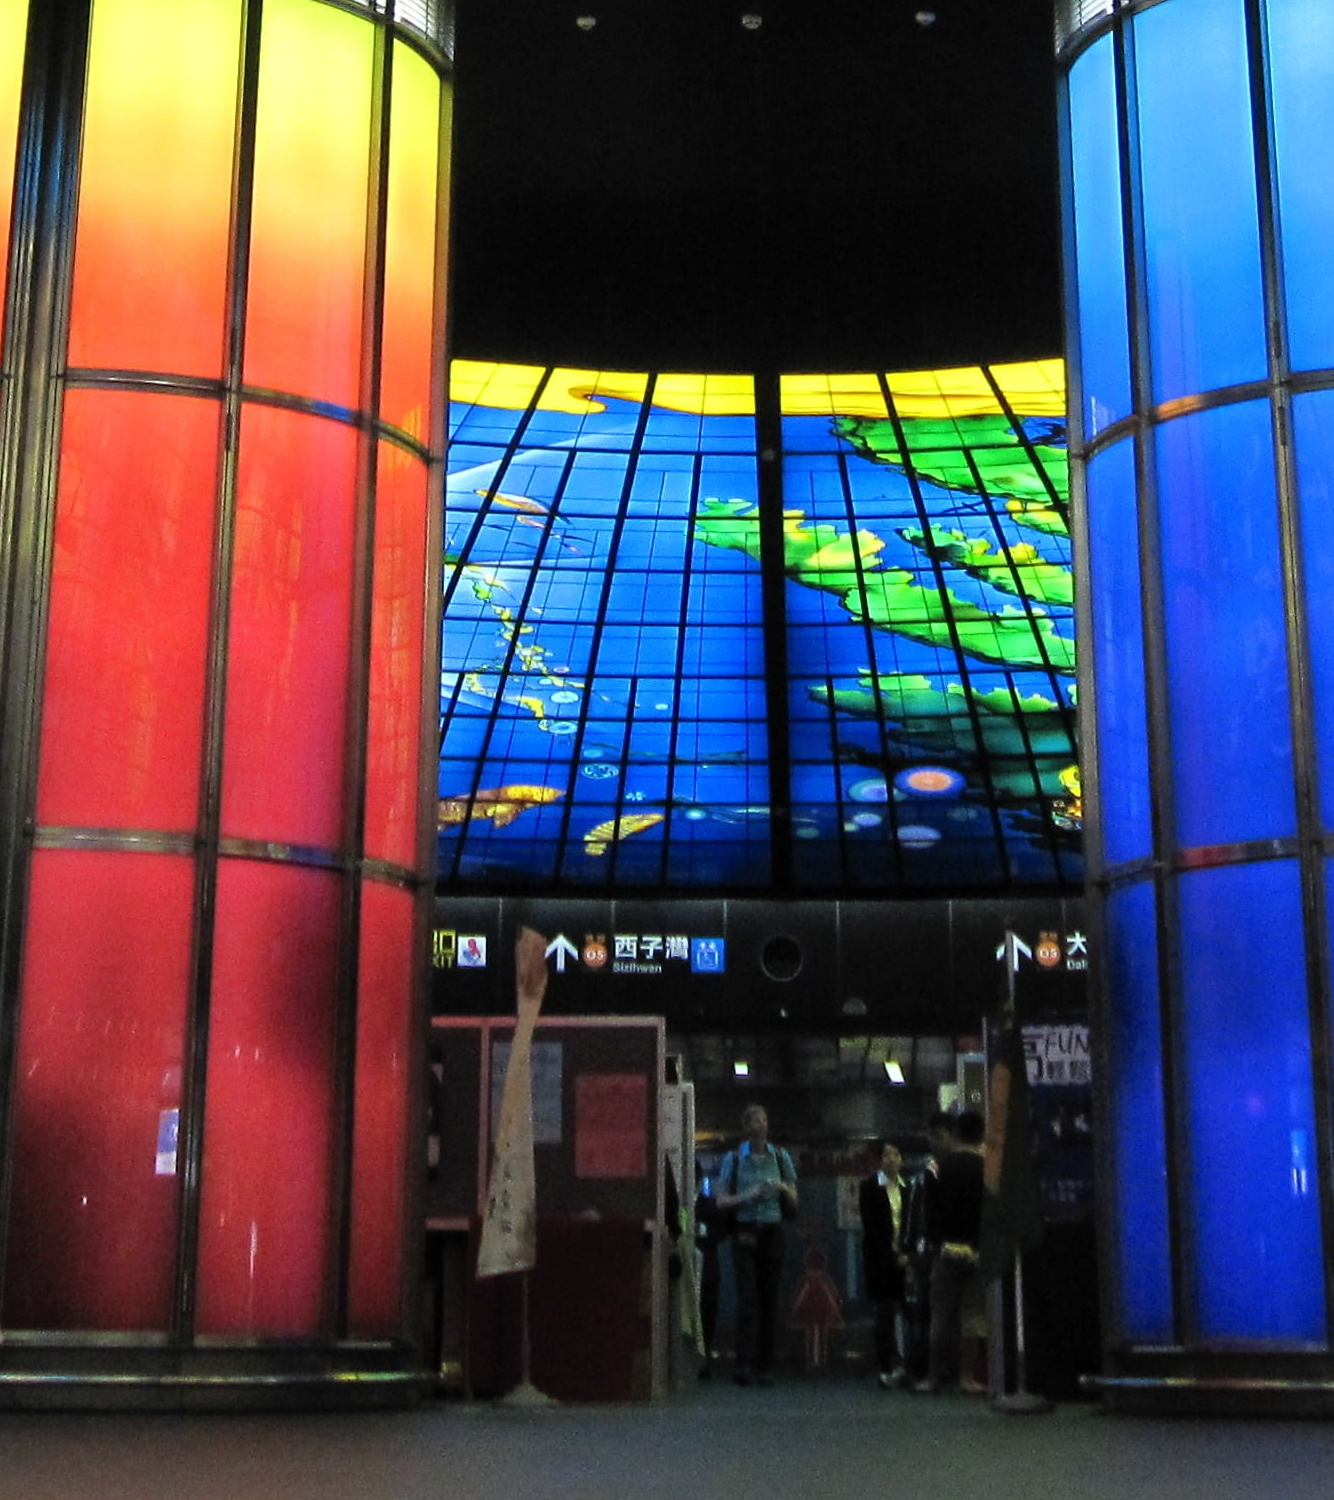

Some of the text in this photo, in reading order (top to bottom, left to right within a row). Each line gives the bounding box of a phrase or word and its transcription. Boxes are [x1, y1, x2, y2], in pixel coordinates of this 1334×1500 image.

[614, 935, 688, 959] 西子灣
[1066, 930, 1088, 956] 大
[613, 962, 662, 973] Sizihwan
